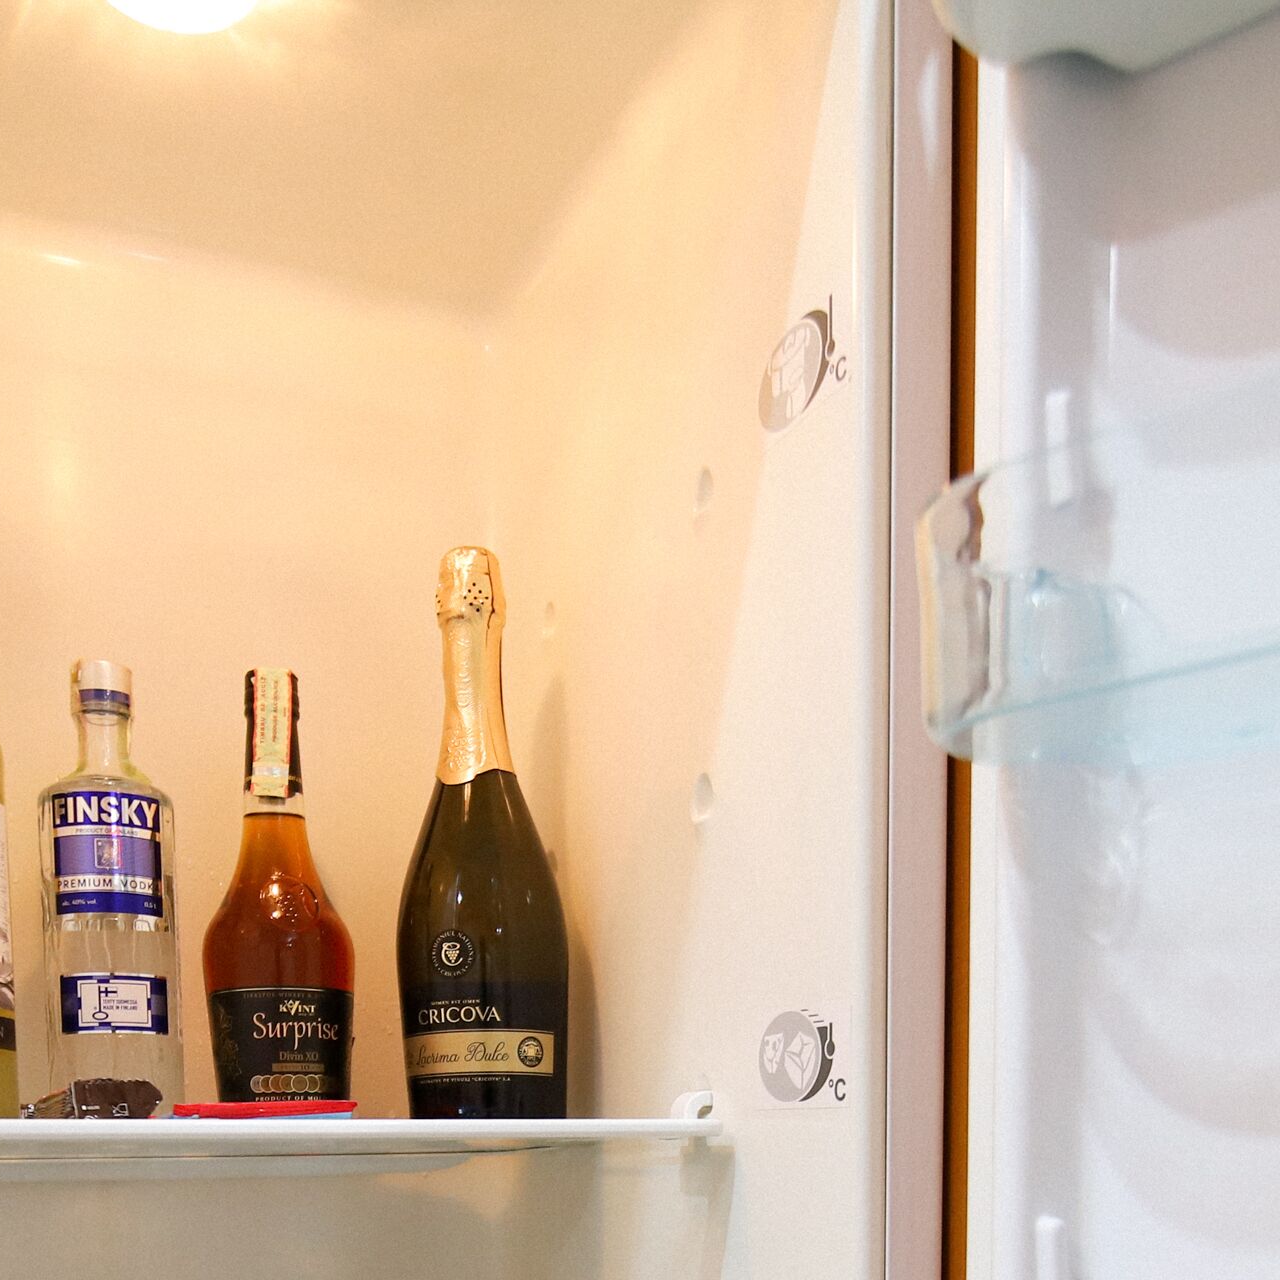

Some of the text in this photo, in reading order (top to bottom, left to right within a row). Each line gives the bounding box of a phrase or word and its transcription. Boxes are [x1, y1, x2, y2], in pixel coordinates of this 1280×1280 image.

[829, 356, 847, 381] °C
[54, 795, 158, 829] FINSKY
[58, 878, 113, 889] PREMIUM
[418, 1005, 502, 1026] CRICOVA
[253, 1012, 339, 1051] Surprise
[279, 1051, 319, 1061] Divin XO
[463, 1041, 510, 1062] Dulce
[828, 1078, 847, 1102] °C
